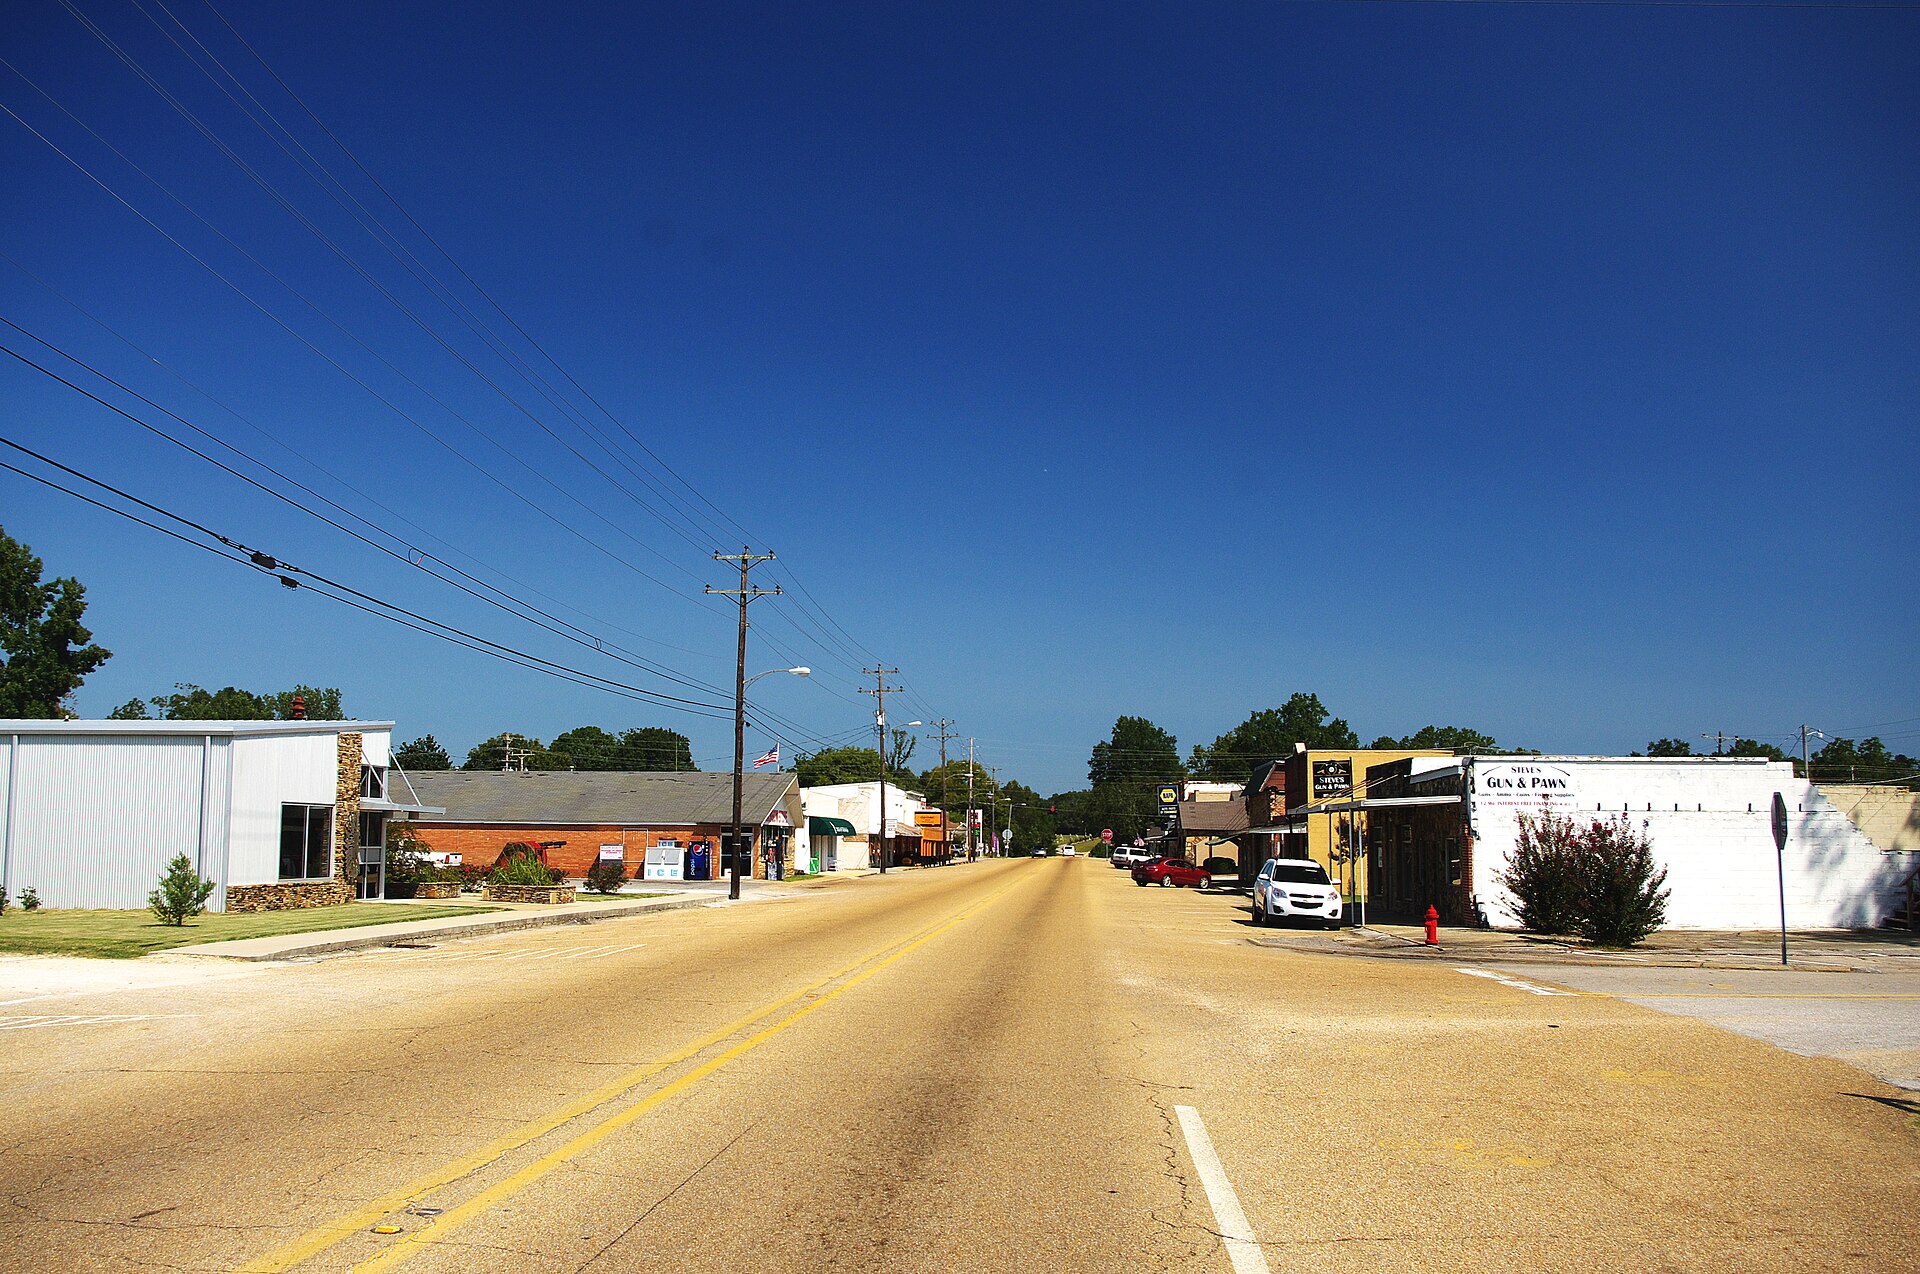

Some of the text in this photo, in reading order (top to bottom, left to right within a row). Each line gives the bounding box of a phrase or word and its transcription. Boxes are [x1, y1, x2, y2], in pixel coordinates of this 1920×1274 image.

[1487, 777, 1566, 788] GUN & PAWN
